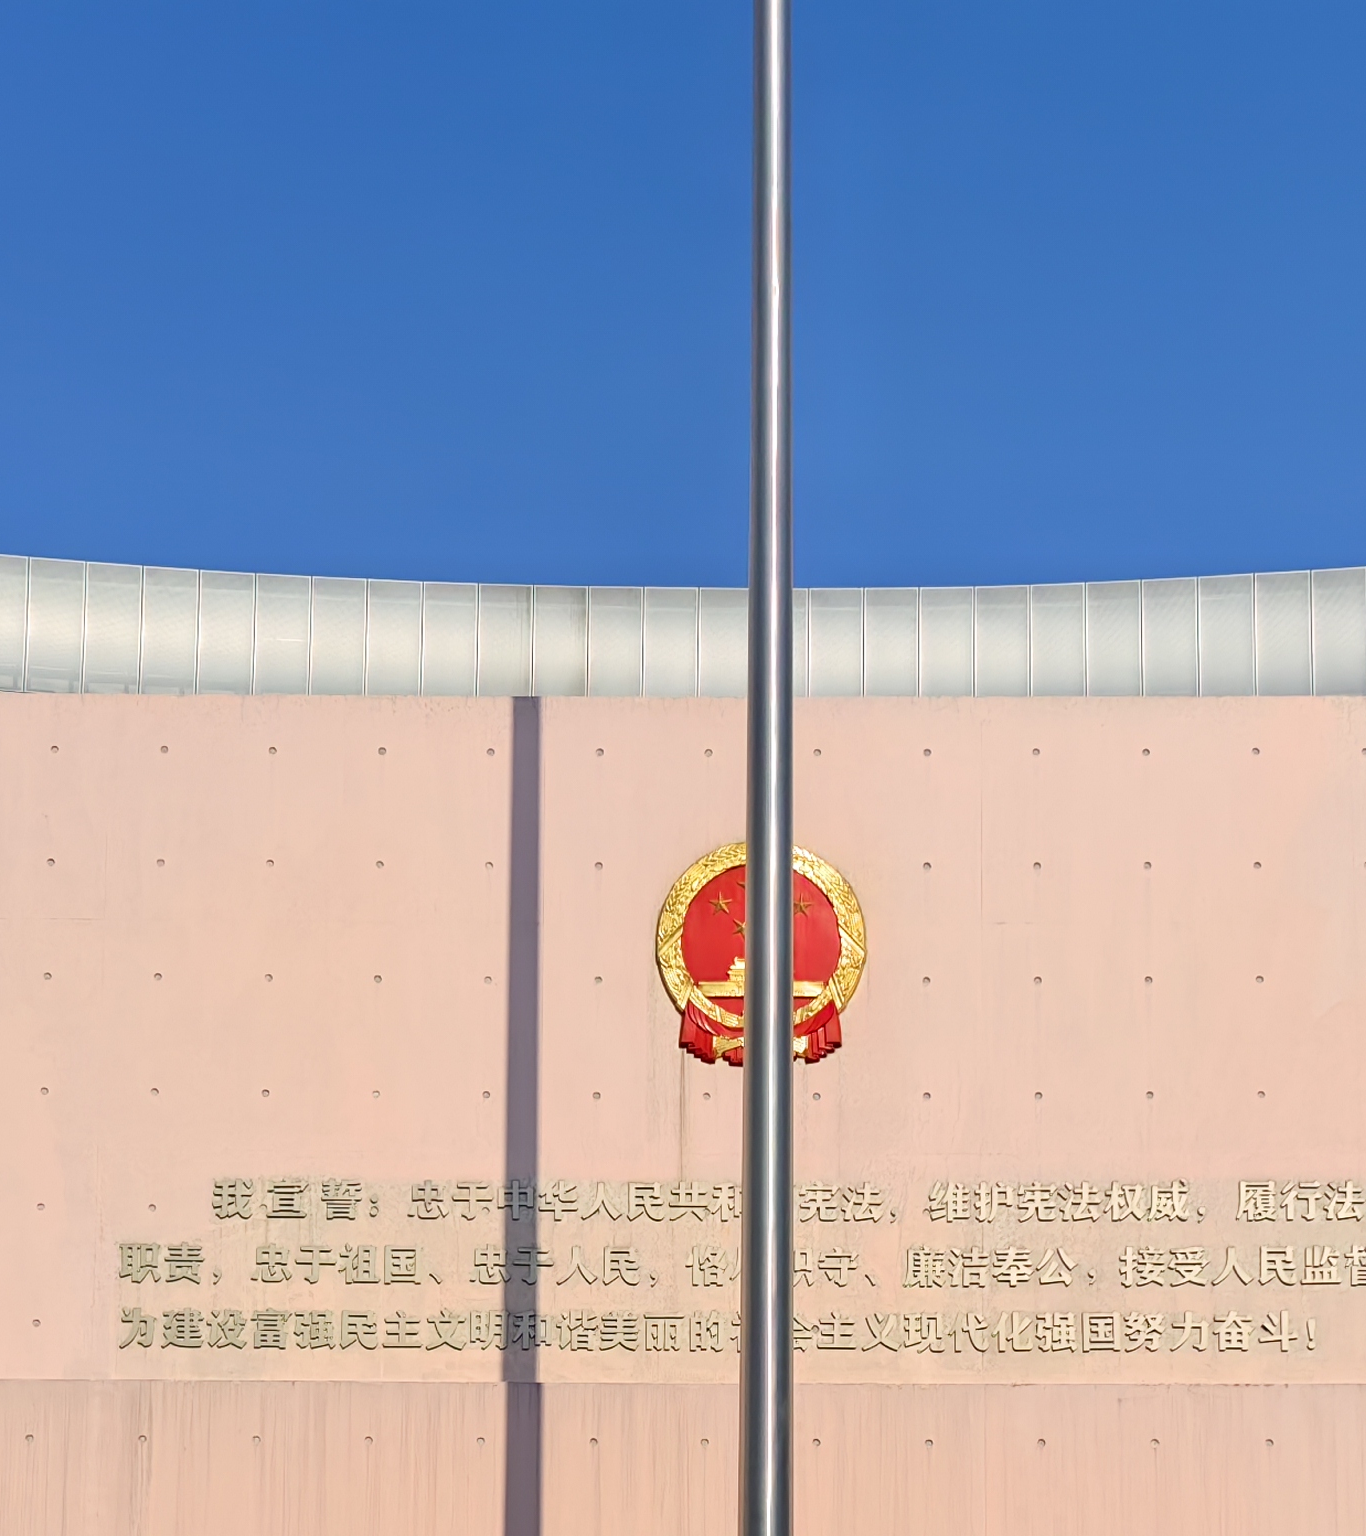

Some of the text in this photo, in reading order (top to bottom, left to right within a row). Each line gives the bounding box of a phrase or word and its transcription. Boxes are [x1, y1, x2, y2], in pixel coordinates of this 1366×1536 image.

[119, 1307, 1317, 1352] 为建设富强民主文明和谐美丽的主义现代化强国努力奋斗！
